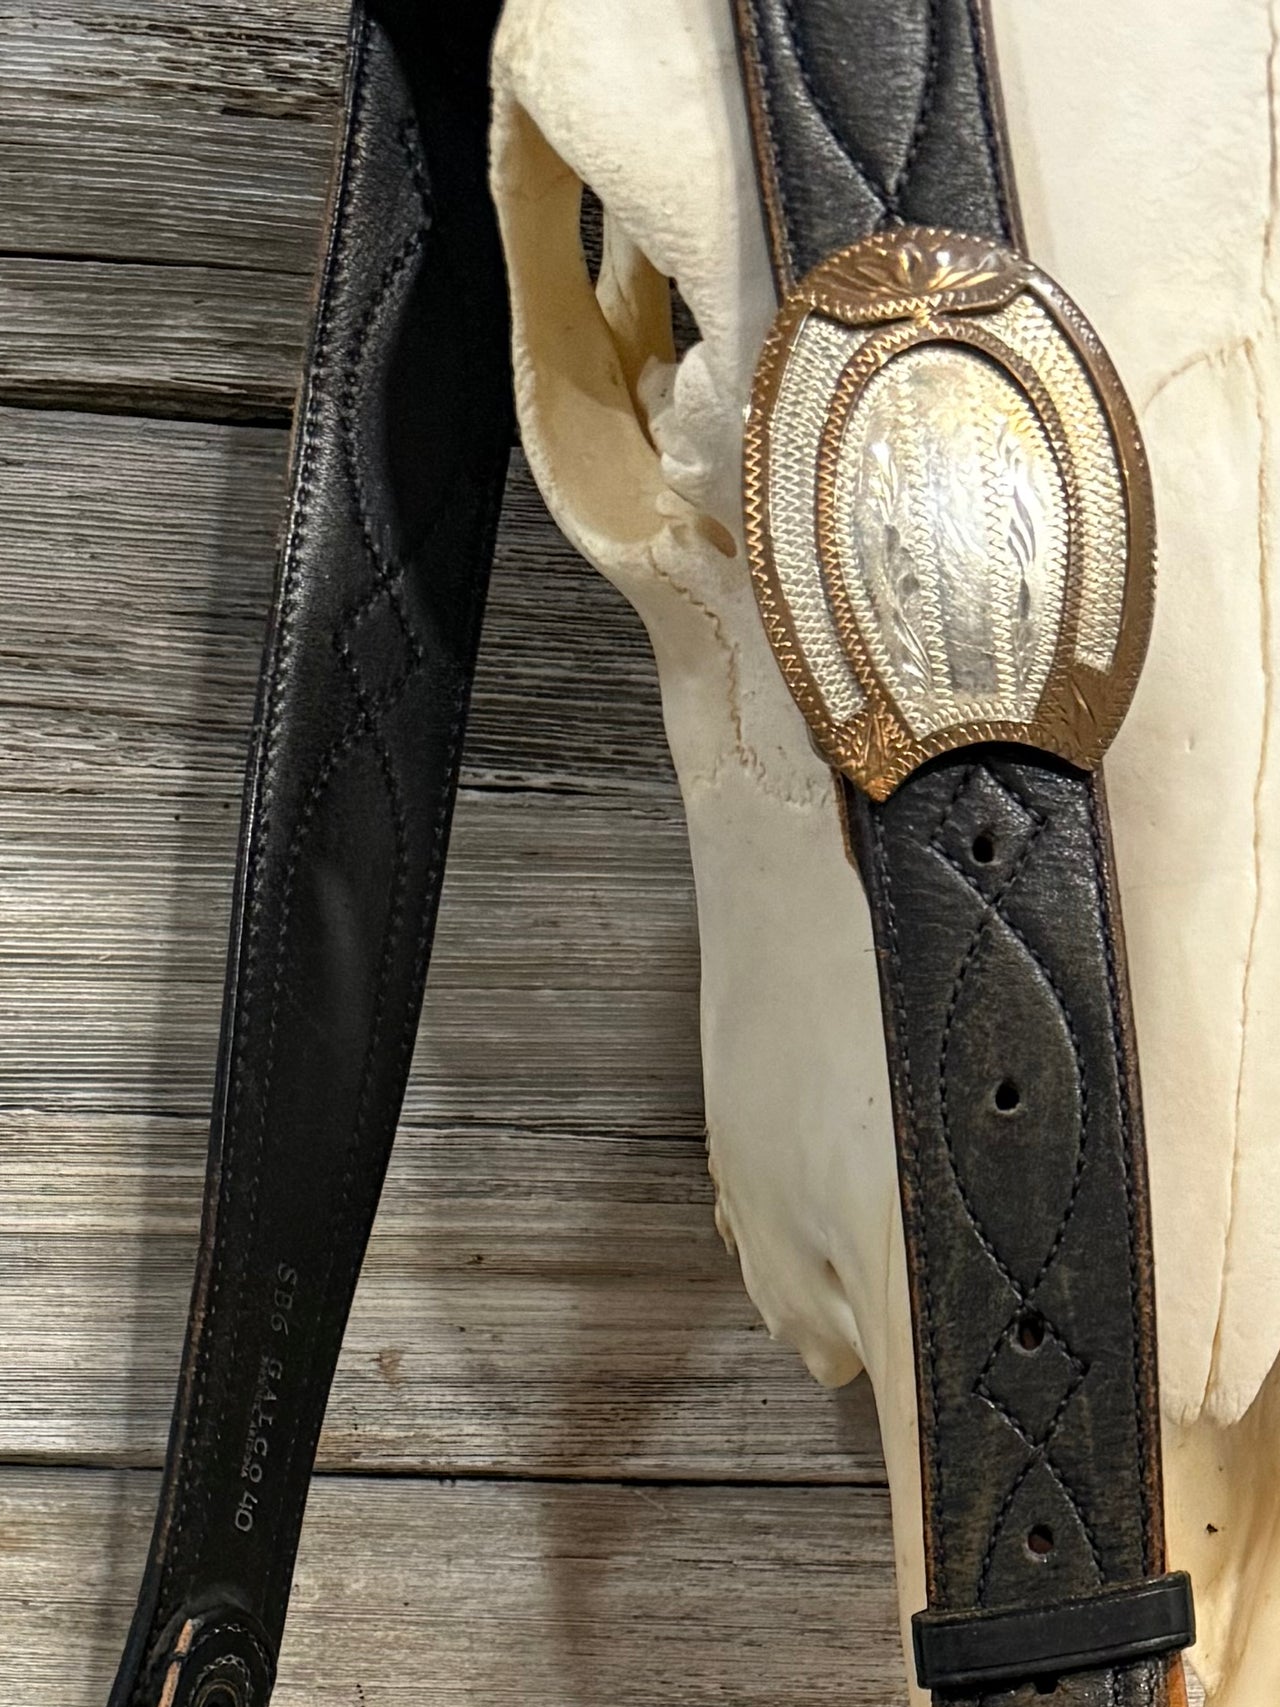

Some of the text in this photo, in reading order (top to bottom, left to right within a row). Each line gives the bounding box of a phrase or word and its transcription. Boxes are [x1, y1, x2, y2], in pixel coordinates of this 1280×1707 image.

[270, 1262, 297, 1335] SB6
[248, 1359, 283, 1482] GALCO
[235, 1490, 258, 1532] 40
